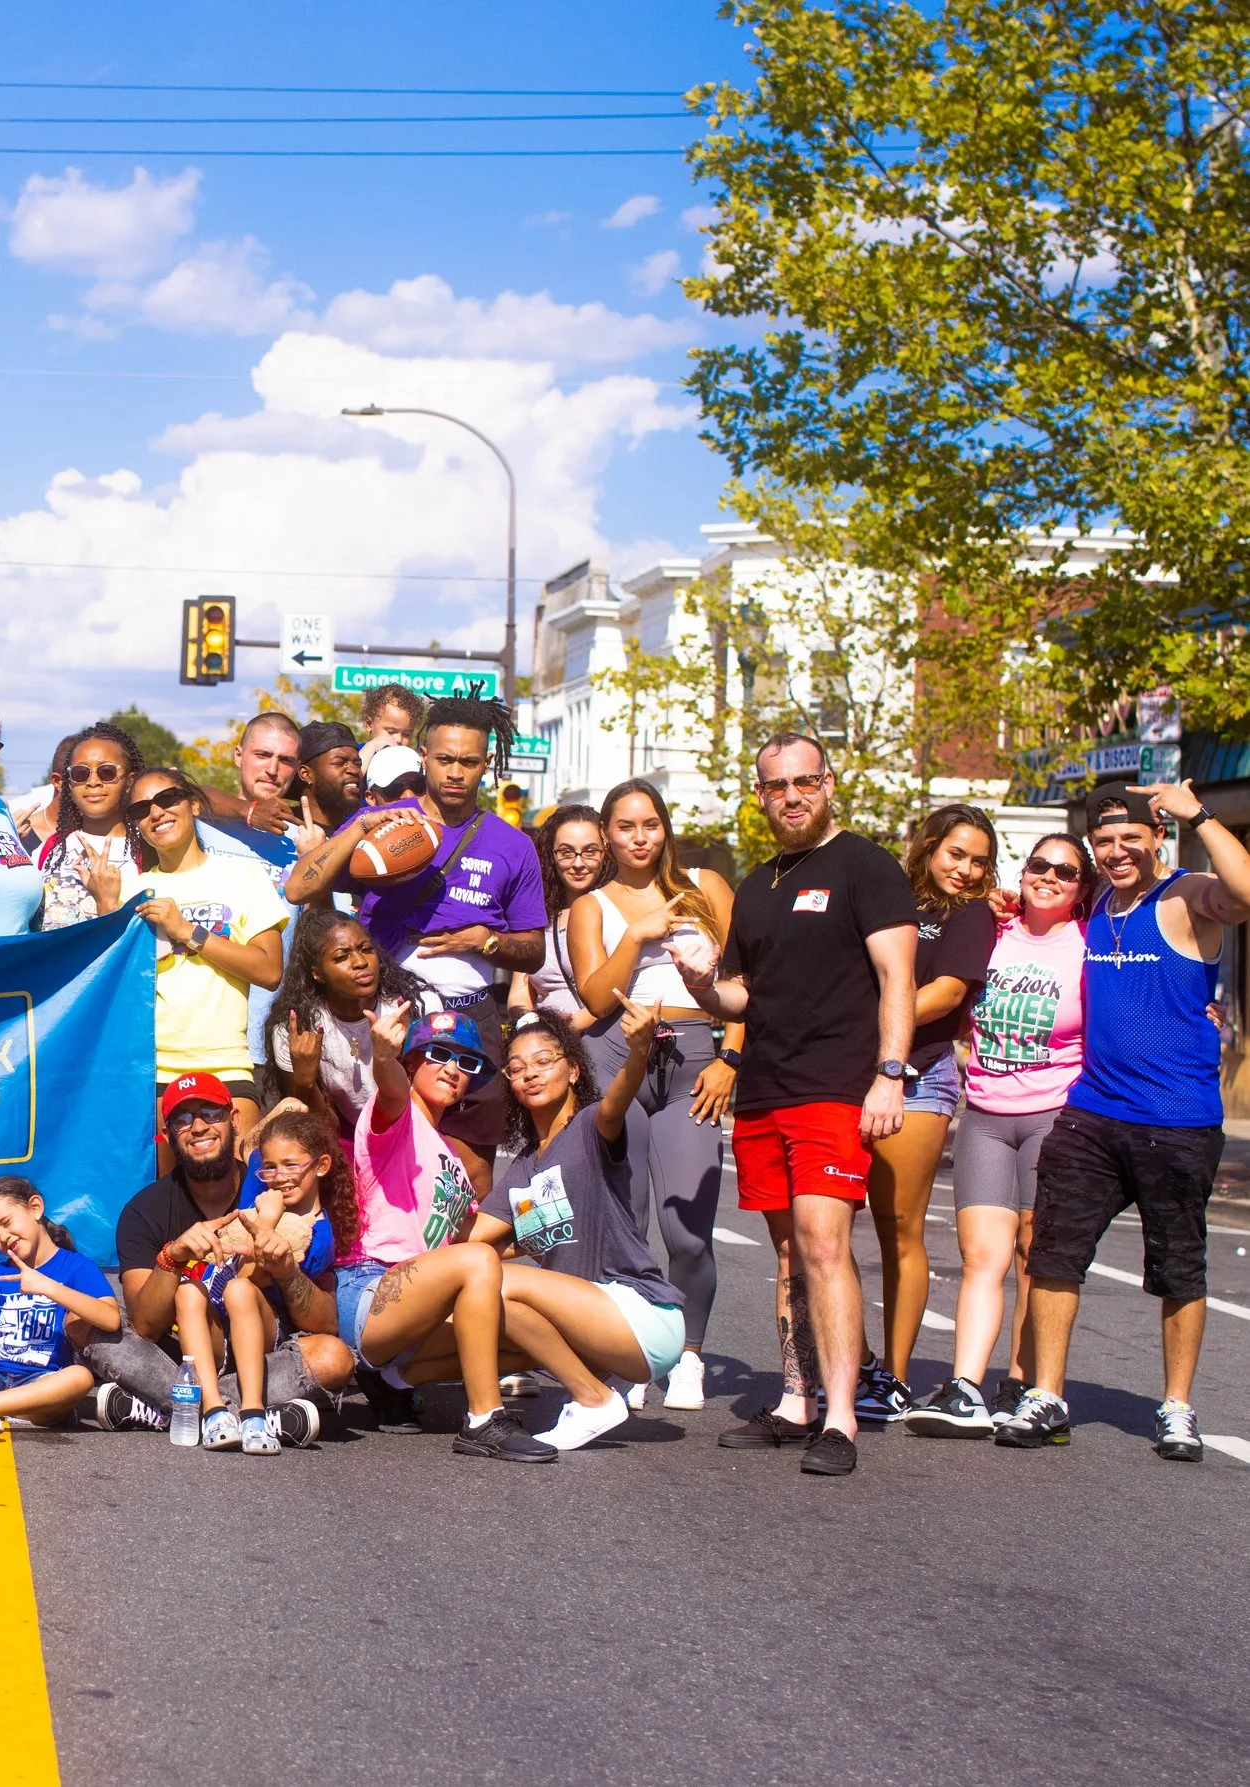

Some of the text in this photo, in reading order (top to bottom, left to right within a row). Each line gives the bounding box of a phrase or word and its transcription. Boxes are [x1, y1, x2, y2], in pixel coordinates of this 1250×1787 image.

[292, 618, 323, 630] ONE
[291, 633, 322, 646] WAY
[1105, 747, 1139, 769] DISCOU
[1143, 749, 1151, 769] 2
[460, 856, 493, 876] SORRY
[469, 873, 481, 888] IN
[448, 886, 493, 906] ADVANCE
[181, 903, 224, 921] ACE
[1086, 948, 1161, 969] hampion
[986, 968, 1062, 1001] THE BLOCK
[445, 988, 489, 1009] NAUTIC
[178, 1077, 196, 1091] RN
